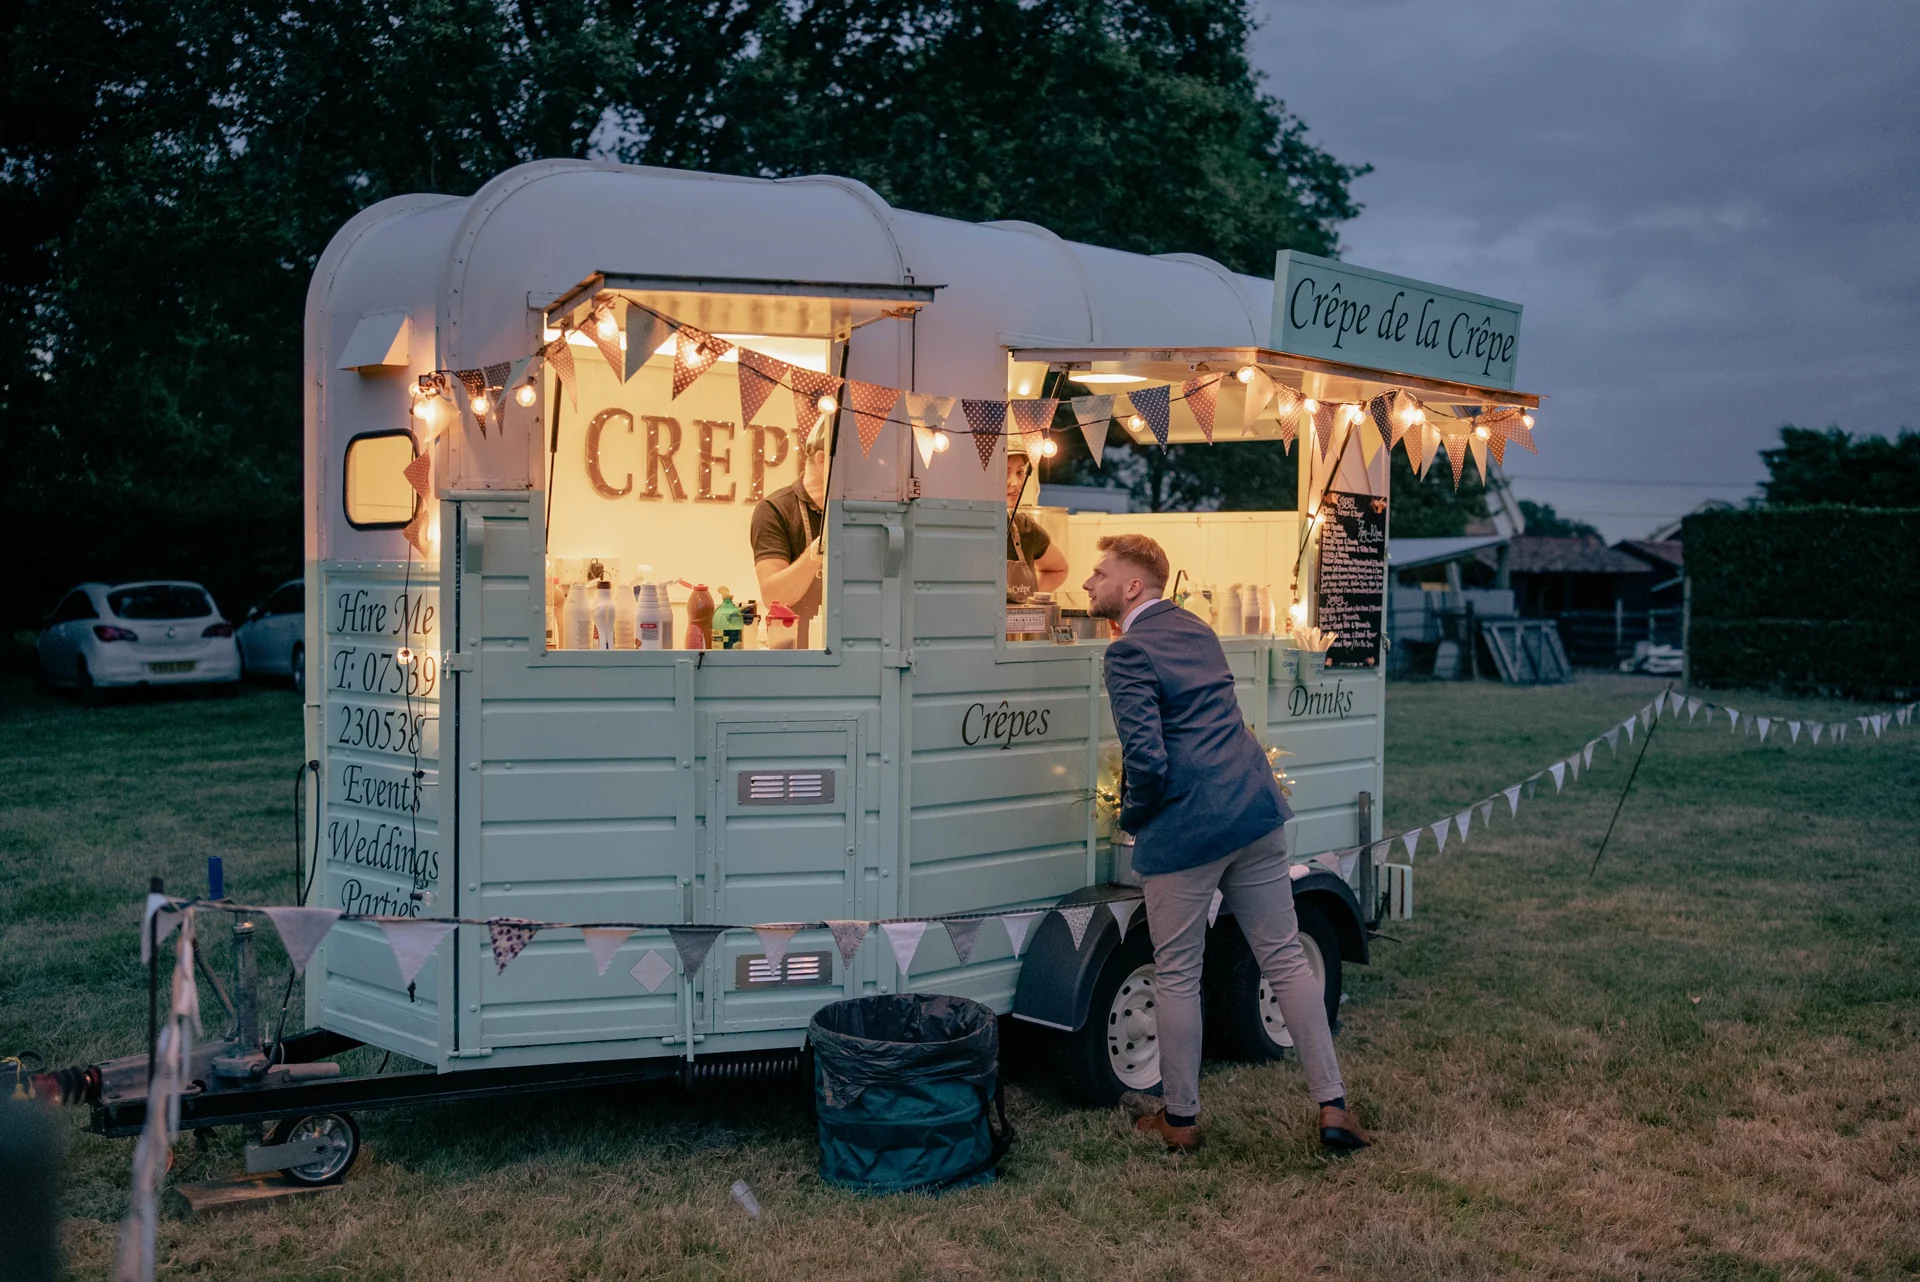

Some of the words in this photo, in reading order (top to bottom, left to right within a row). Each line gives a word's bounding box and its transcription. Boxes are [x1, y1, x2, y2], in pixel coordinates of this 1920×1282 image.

[1290, 277, 1371, 349] Crêpe
[1377, 291, 1409, 342] de
[1415, 298, 1441, 349] la
[1448, 312, 1515, 376] Crêpe
[586, 407, 804, 505] CREP
[337, 589, 387, 634] Hire
[393, 593, 434, 636] Me
[334, 649, 355, 690] T:
[363, 652, 437, 696] 07539
[1287, 678, 1354, 719] Drinks
[339, 705, 424, 755] 230538
[962, 699, 1051, 751] Crêpes
[343, 764, 423, 814] Events
[328, 818, 439, 881] Weddings
[342, 879, 421, 918] Parties
